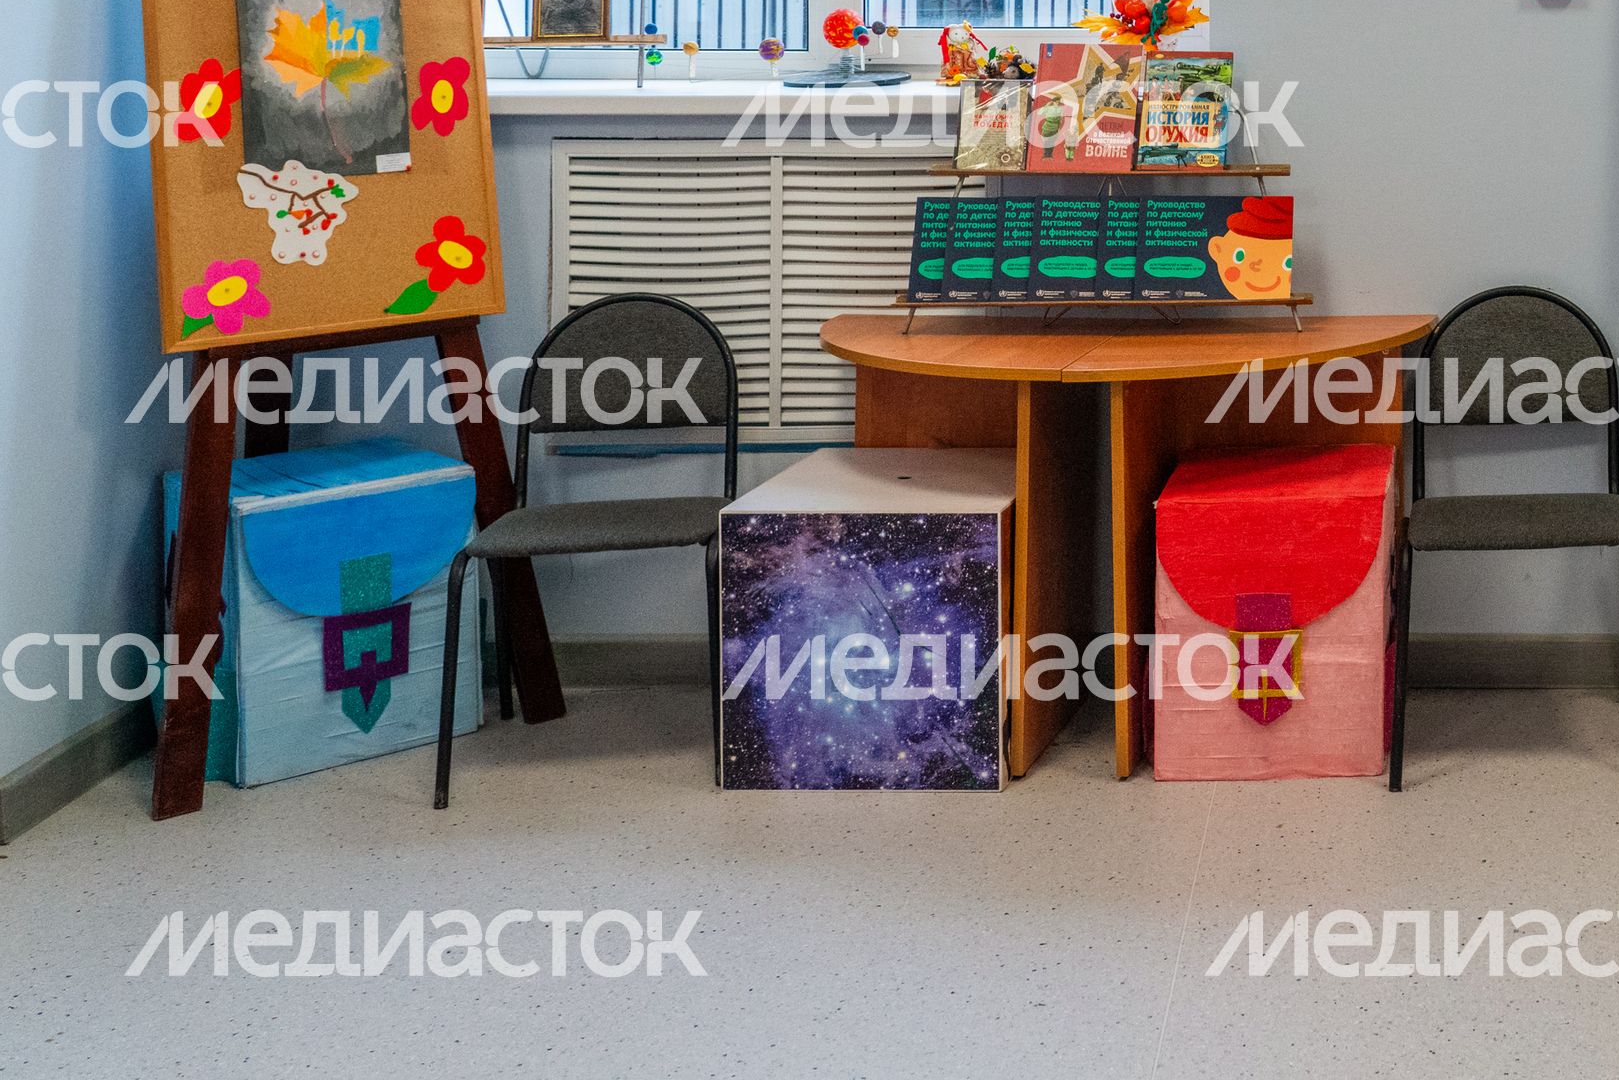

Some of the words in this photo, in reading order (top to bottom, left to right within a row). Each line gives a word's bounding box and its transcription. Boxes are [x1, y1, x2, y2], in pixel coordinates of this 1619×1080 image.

[1147, 111, 1209, 125] ИСТОРИЯ
[1145, 125, 1208, 143] ОРУЖИЯ
[1085, 143, 1128, 158] ВОЙНЕ
[1042, 199, 1101, 210] Руководство
[1147, 199, 1206, 210] Руководство
[1005, 211, 1017, 219] по
[1055, 211, 1100, 220] детскому
[1160, 211, 1204, 220] детскому
[1153, 228, 1208, 238] физической
[1039, 239, 1093, 247] активности
[1145, 239, 1198, 247] активности
